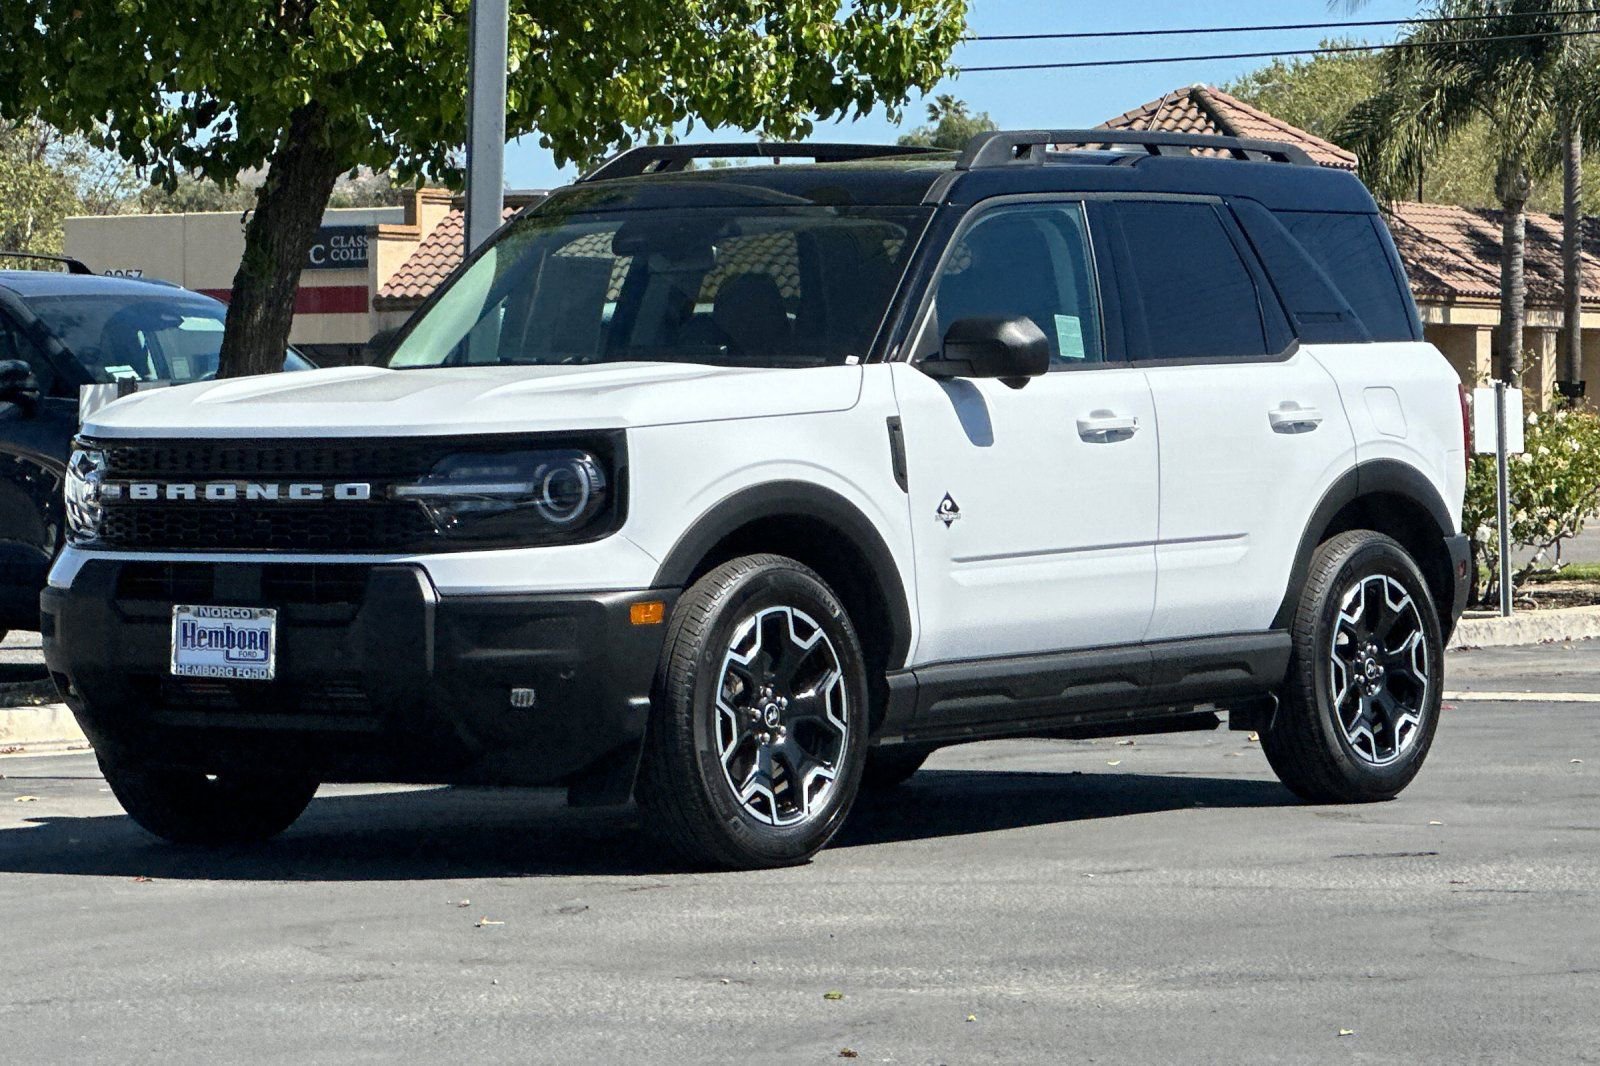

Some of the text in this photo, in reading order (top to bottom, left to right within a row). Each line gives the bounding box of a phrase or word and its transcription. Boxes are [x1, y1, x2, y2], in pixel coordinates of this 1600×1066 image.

[331, 235, 369, 248] CLASS
[129, 483, 371, 500] BRONCO
[199, 606, 251, 619] NORCO
[239, 650, 258, 658] FORD
[177, 664, 268, 679] HEMBORG FORD
